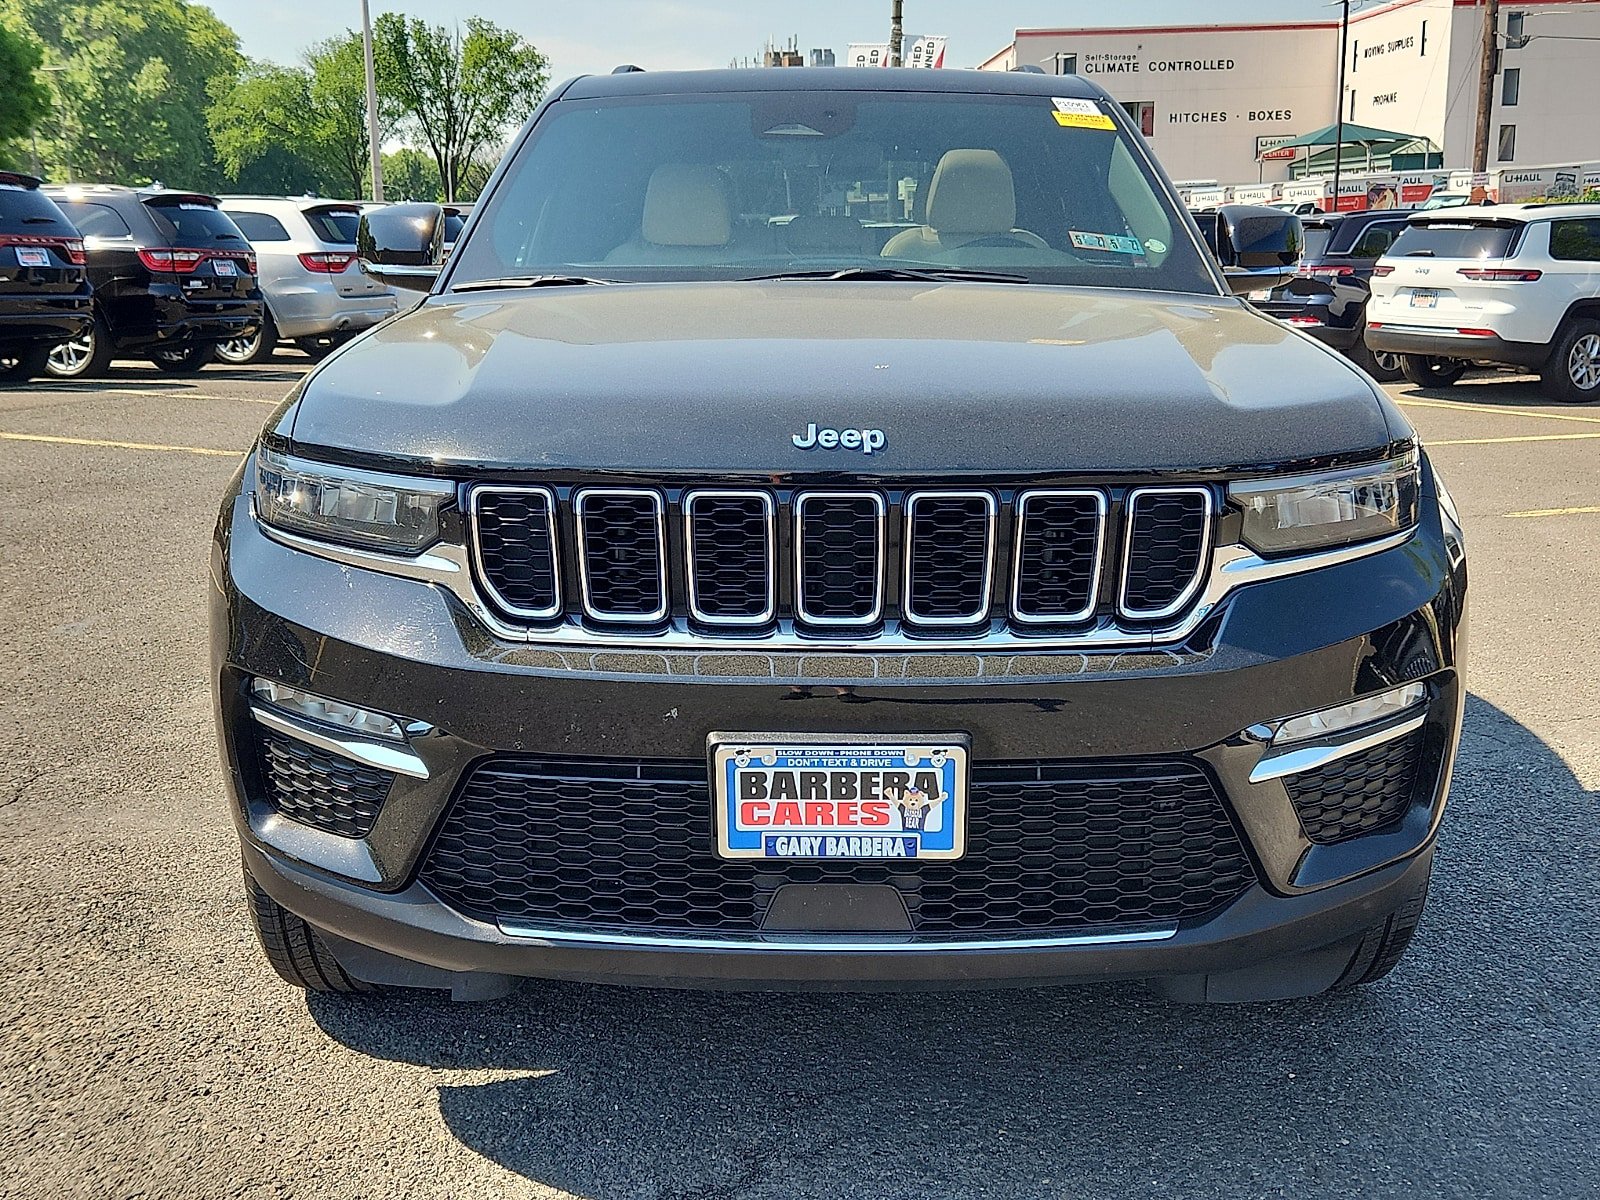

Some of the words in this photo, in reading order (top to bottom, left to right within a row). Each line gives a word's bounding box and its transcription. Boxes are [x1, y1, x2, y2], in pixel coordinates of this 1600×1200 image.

[1387, 36, 1414, 53] SUPPLIES
[1085, 62, 1140, 74] CLIMATE
[1148, 59, 1235, 72] CONTROLLED
[1372, 91, 1398, 107] PROPANE
[1169, 112, 1227, 123] HITCHES
[1248, 110, 1292, 121] BOXES
[1402, 176, 1424, 185] AUL
[1504, 173, 1542, 183] U-HAUL
[1239, 192, 1266, 200] U-HAUL
[1288, 189, 1318, 198] U-HAUL
[792, 422, 886, 456] Jeep
[787, 758, 820, 767] DON'T
[821, 758, 849, 767] TEXT
[849, 758, 859, 767] &
[860, 758, 892, 767] DRIVE
[740, 771, 940, 800] BARBERA
[740, 802, 891, 826] CARES
[775, 836, 823, 856] GARY
[825, 837, 907, 857] BARBERA
